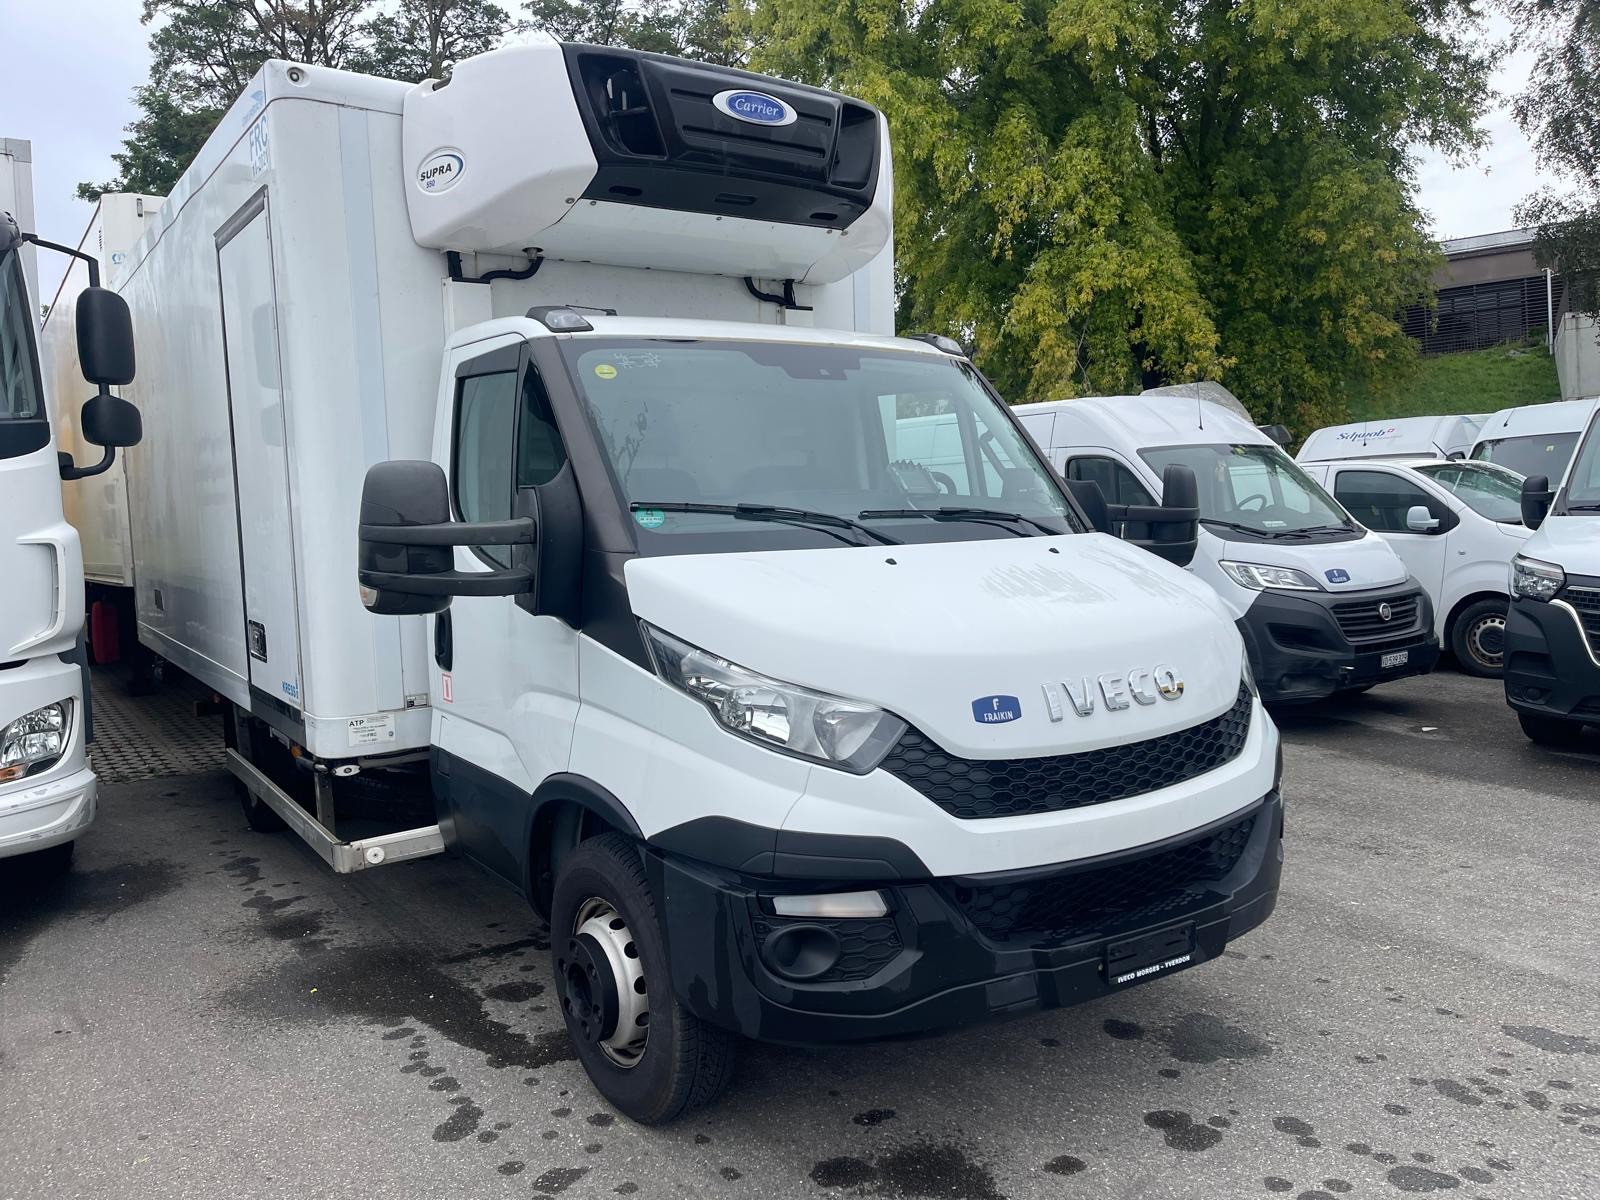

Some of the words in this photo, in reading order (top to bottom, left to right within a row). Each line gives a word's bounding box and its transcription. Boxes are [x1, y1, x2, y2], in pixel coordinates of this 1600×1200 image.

[735, 98, 780, 116] Carrier
[249, 114, 268, 162] FRC
[420, 163, 452, 182] SUPRA
[1040, 664, 1185, 723] IVECO
[349, 719, 365, 727] ATP
[983, 711, 1014, 721] FRAIKIN
[1117, 972, 1136, 984] IVECO
[1136, 964, 1160, 977] MORGES
[1164, 955, 1191, 968] YVERDON
